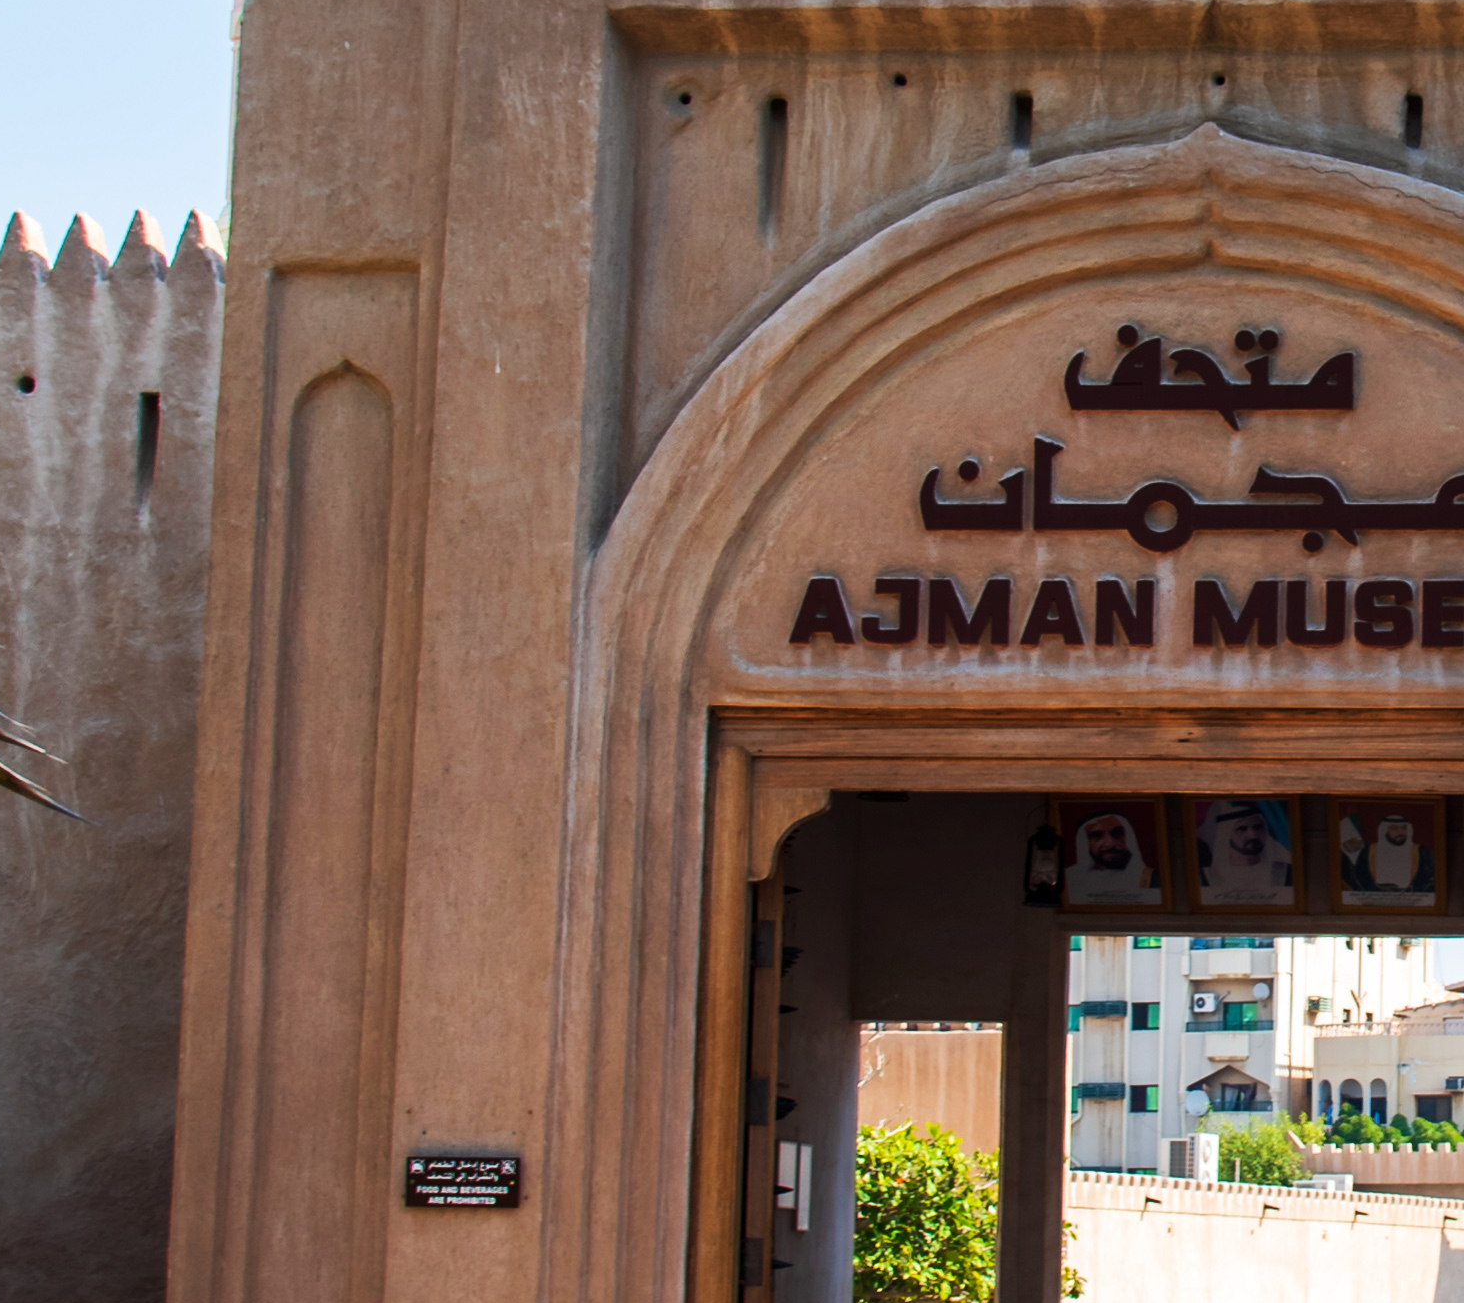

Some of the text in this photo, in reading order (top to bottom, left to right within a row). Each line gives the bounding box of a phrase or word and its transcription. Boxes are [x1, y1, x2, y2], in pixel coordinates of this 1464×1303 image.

[1064, 323, 1356, 431] متحف
[788, 575, 1157, 649] AJMAN
[416, 1185, 440, 1194] FOOD
[440, 1186, 458, 1194] AND
